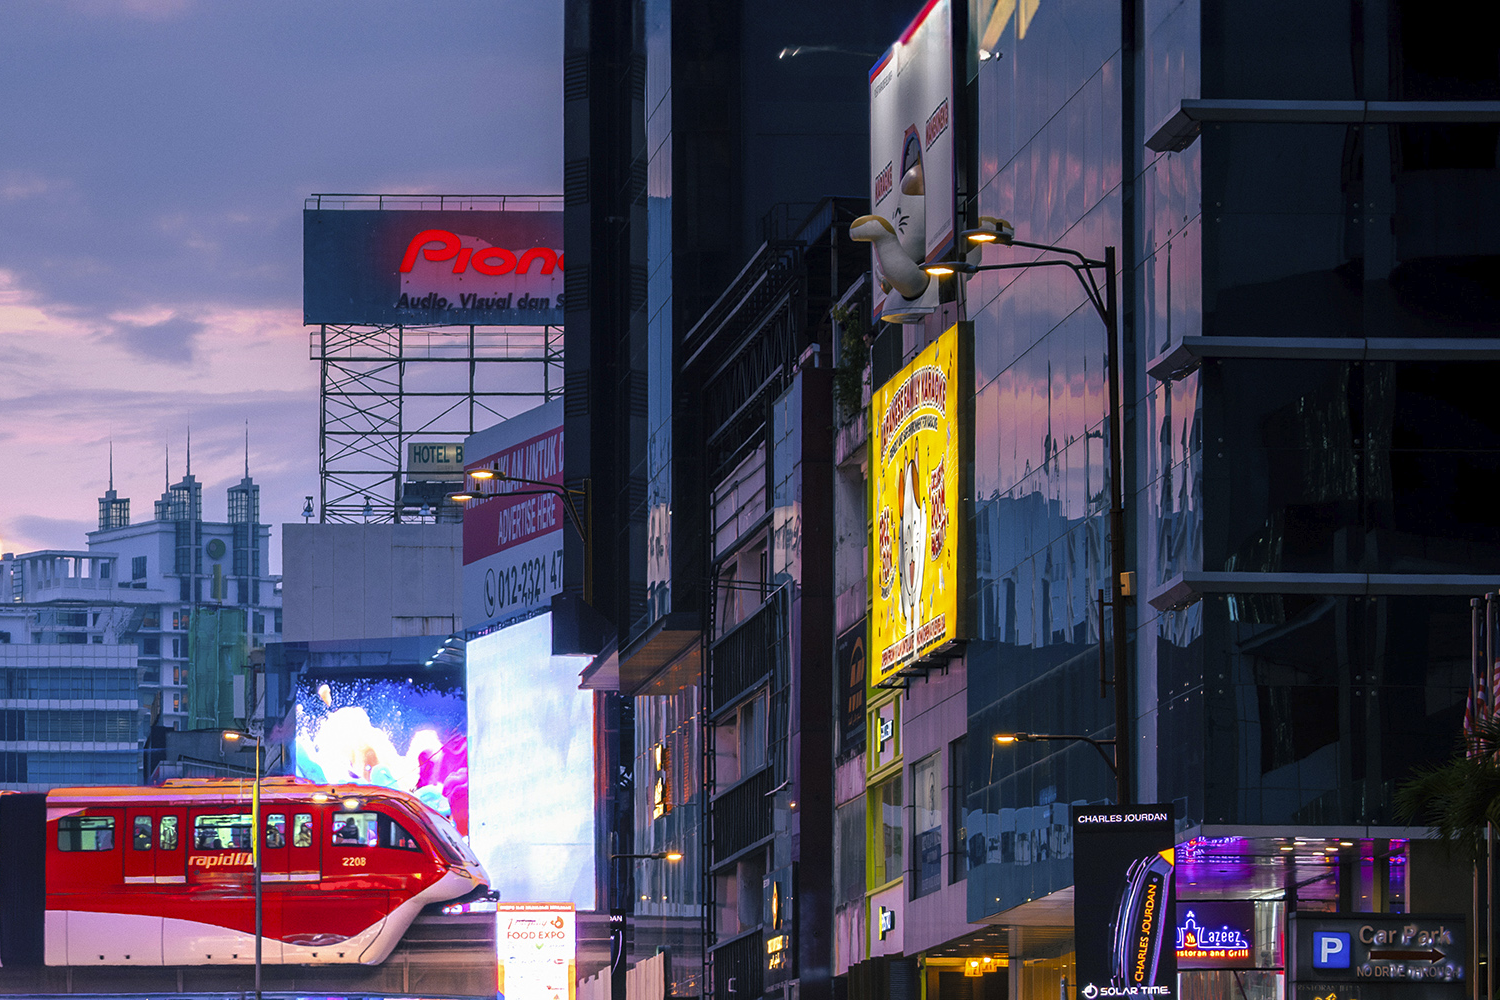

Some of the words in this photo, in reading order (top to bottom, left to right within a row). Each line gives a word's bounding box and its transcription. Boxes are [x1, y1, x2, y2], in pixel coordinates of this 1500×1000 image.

[396, 292, 454, 311] Audio,
[459, 293, 513, 310] Visual
[517, 293, 550, 310] dan
[413, 445, 450, 464] HOTEL
[498, 498, 535, 546] ADVERTISE
[537, 492, 556, 532] HERE
[1078, 814, 1122, 824] CHARLES
[1124, 813, 1168, 822] JOURDAN
[342, 857, 367, 867] 2208
[1141, 884, 1157, 936] JOURDAN
[507, 931, 536, 939] FOOD
[538, 931, 565, 939] EXPO
[1200, 927, 1242, 944] Lazeez
[1321, 937, 1343, 963] P
[1359, 925, 1397, 944] Car
[1402, 925, 1451, 945] Park
[1134, 935, 1150, 982] CHARLES
[1209, 949, 1226, 957] and
[1228, 949, 1248, 957] Grill
[1357, 966, 1372, 977] NO
[1375, 966, 1405, 977] DRIVE
[1408, 966, 1462, 979] THROUGH
[1100, 987, 1138, 996] SOLAR
